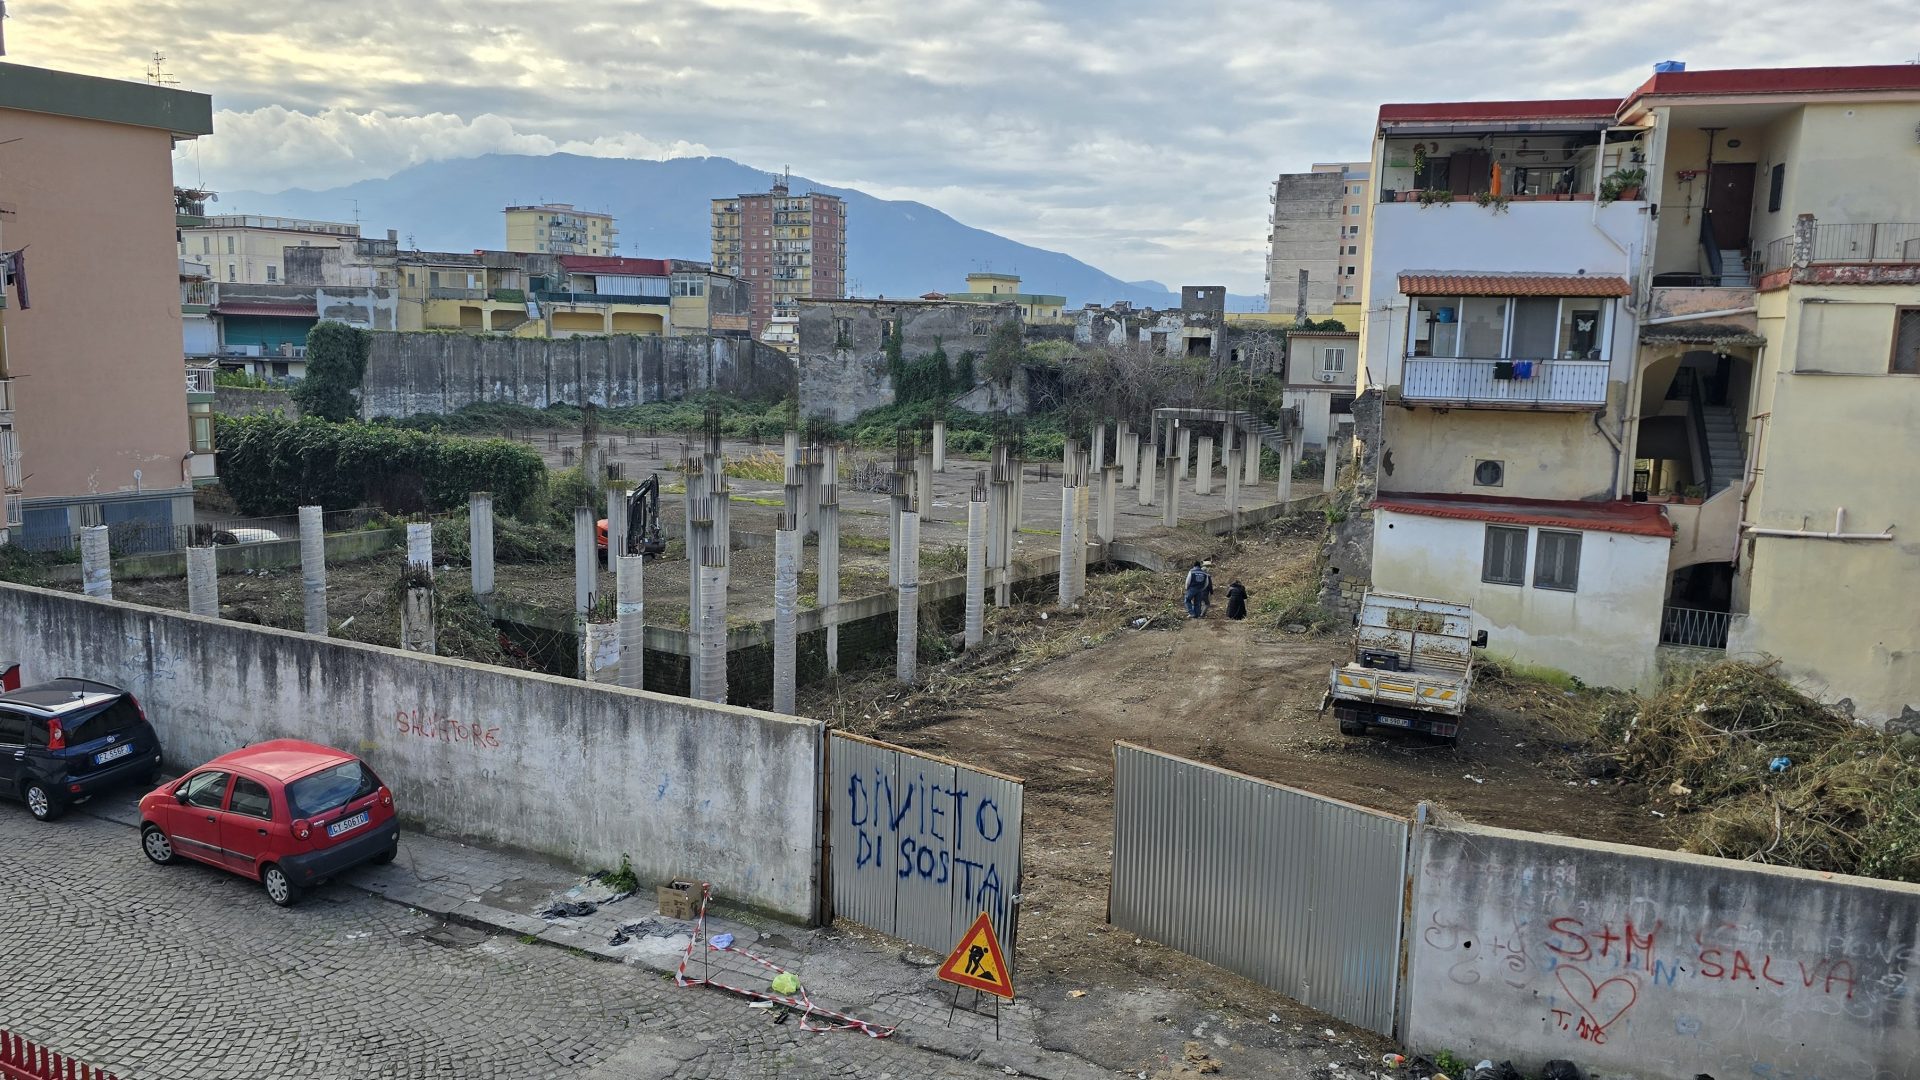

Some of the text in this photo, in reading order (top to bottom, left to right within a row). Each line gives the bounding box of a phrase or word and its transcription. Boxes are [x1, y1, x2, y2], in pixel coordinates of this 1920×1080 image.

[396, 709, 500, 748] SALVATORE
[856, 828, 1003, 916] DI SOSTA
[1698, 949, 1857, 1000] SALVA
